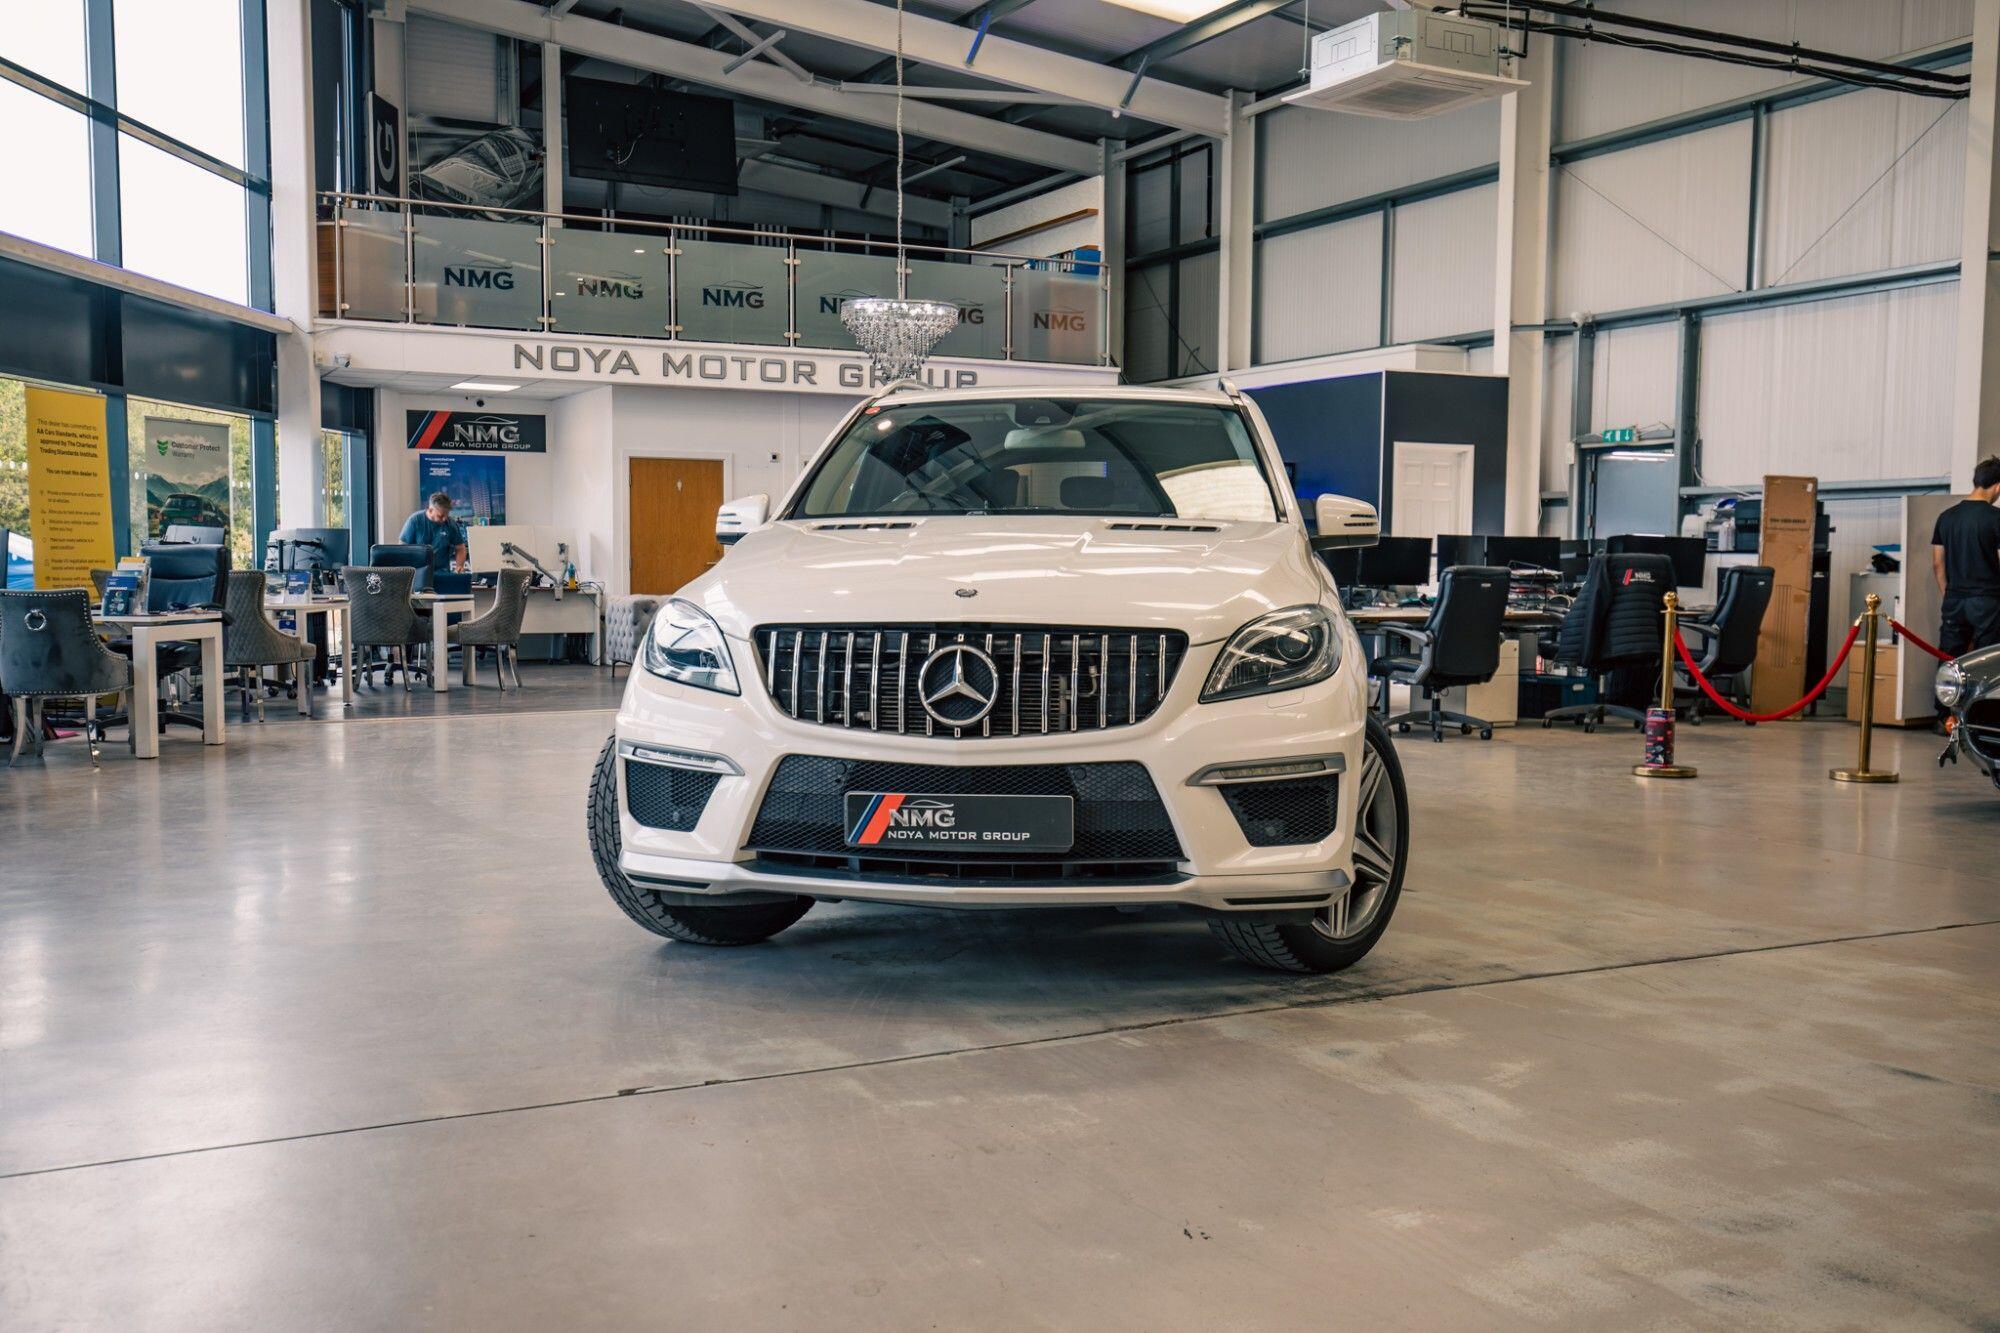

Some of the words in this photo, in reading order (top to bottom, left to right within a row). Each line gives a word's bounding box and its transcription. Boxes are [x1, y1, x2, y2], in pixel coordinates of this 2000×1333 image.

[444, 267, 515, 291] NMG
[577, 279, 644, 300] NMG
[702, 288, 765, 310] NMG
[1033, 312, 1086, 331] NMG
[514, 344, 639, 376] NOYA
[662, 352, 818, 385] MOTOR
[839, 363, 978, 389] GRUP
[453, 423, 520, 443] NMG
[200, 444, 220, 452] Protect
[888, 808, 955, 828] NMG
[888, 830, 924, 840] NOYA
[929, 831, 977, 841] MOTOR
[982, 832, 1031, 842] GROUP
